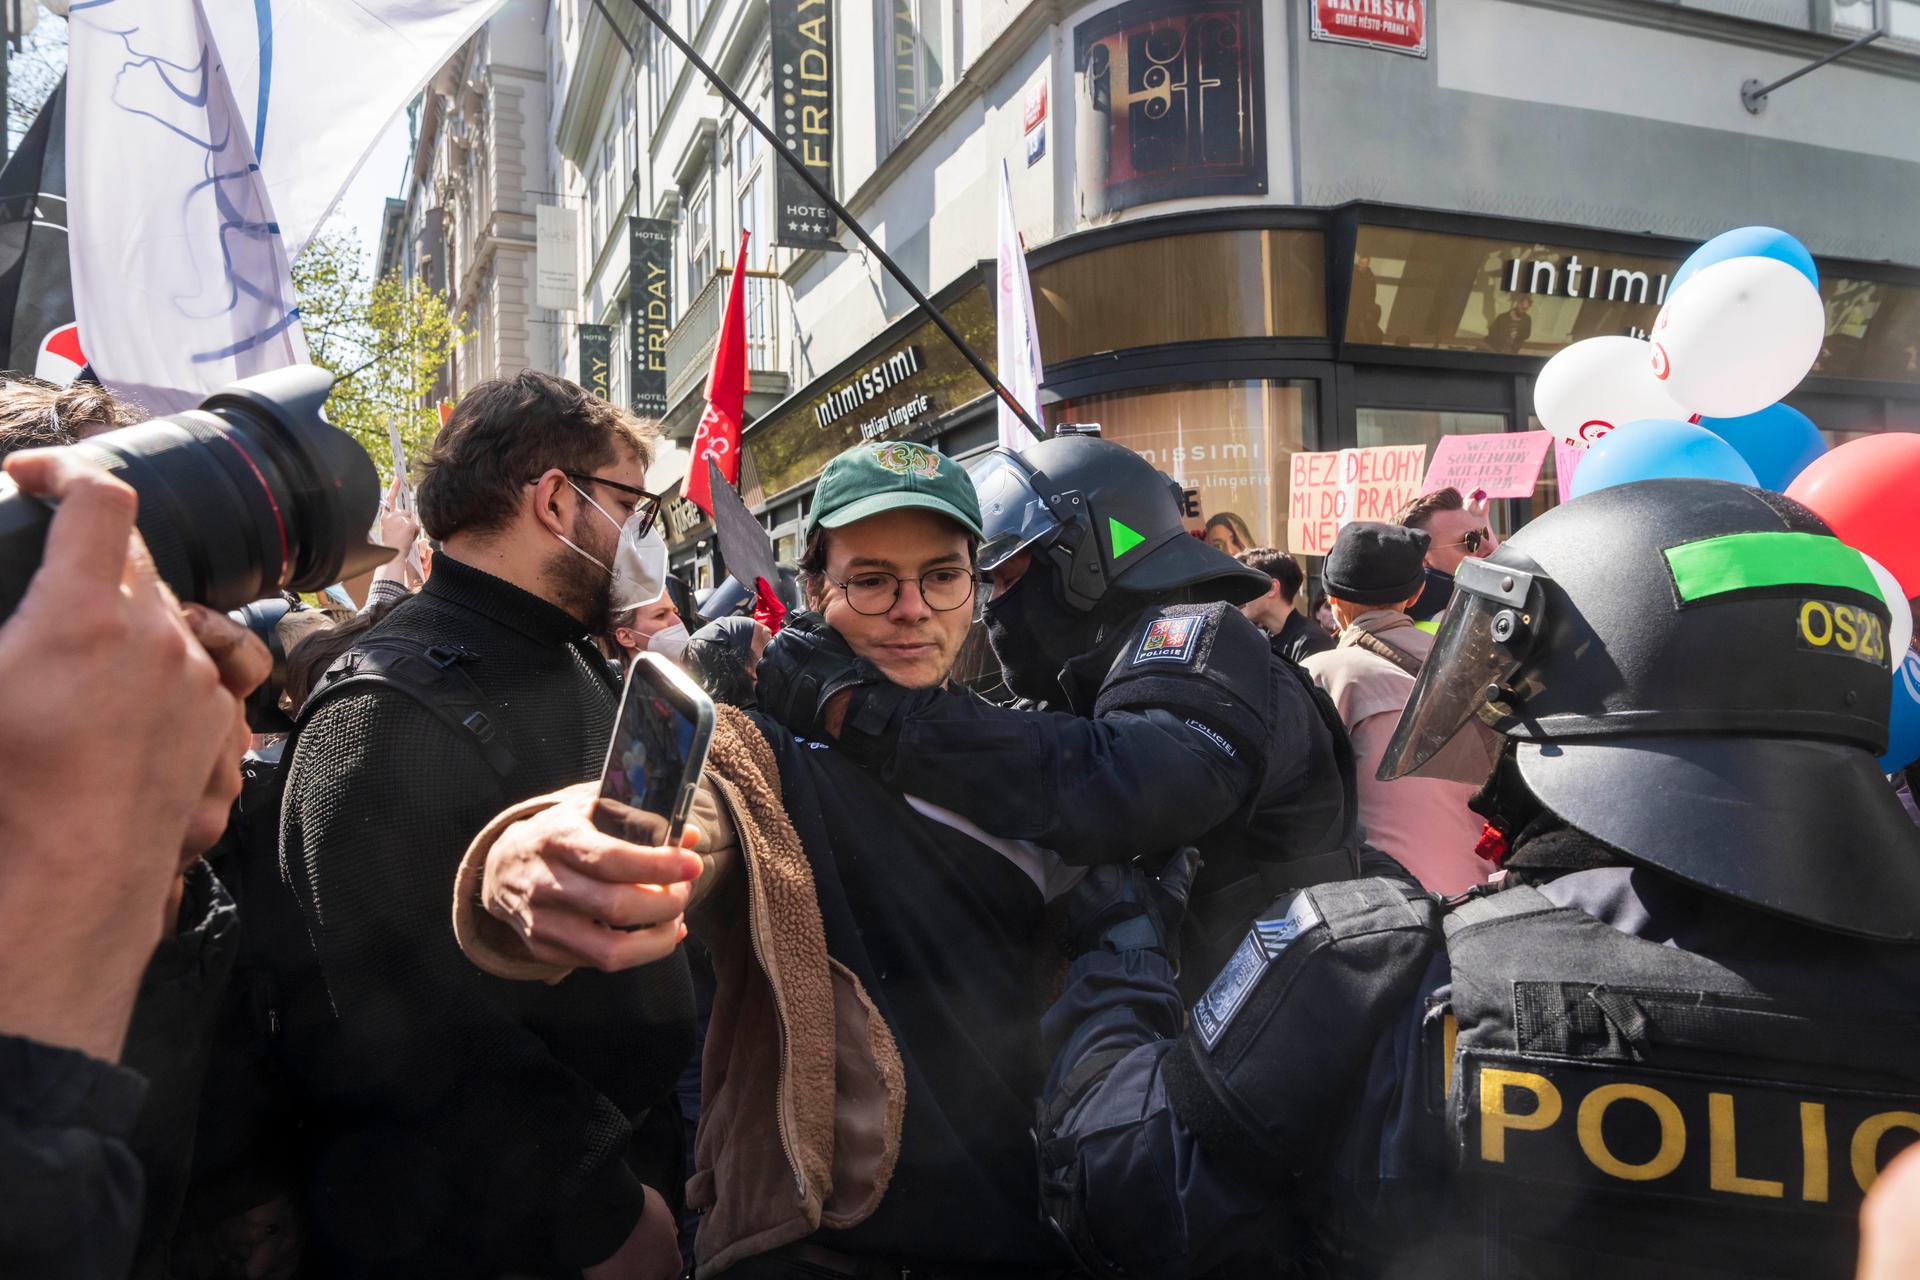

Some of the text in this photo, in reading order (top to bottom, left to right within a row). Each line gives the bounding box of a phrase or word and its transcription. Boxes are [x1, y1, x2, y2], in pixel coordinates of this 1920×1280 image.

[635, 231, 666, 241] HOTEL
[648, 261, 667, 372] FRIDAY
[583, 334, 608, 342] HOTEL
[814, 345, 918, 429] intimissimi
[860, 393, 929, 441] Italian lingerie
[1294, 454, 1338, 488] BEZ
[1292, 490, 1311, 519] MI
[1321, 490, 1346, 519] DO
[1139, 649, 1182, 660] POLICIE
[1190, 719, 1233, 752] POLICIE
